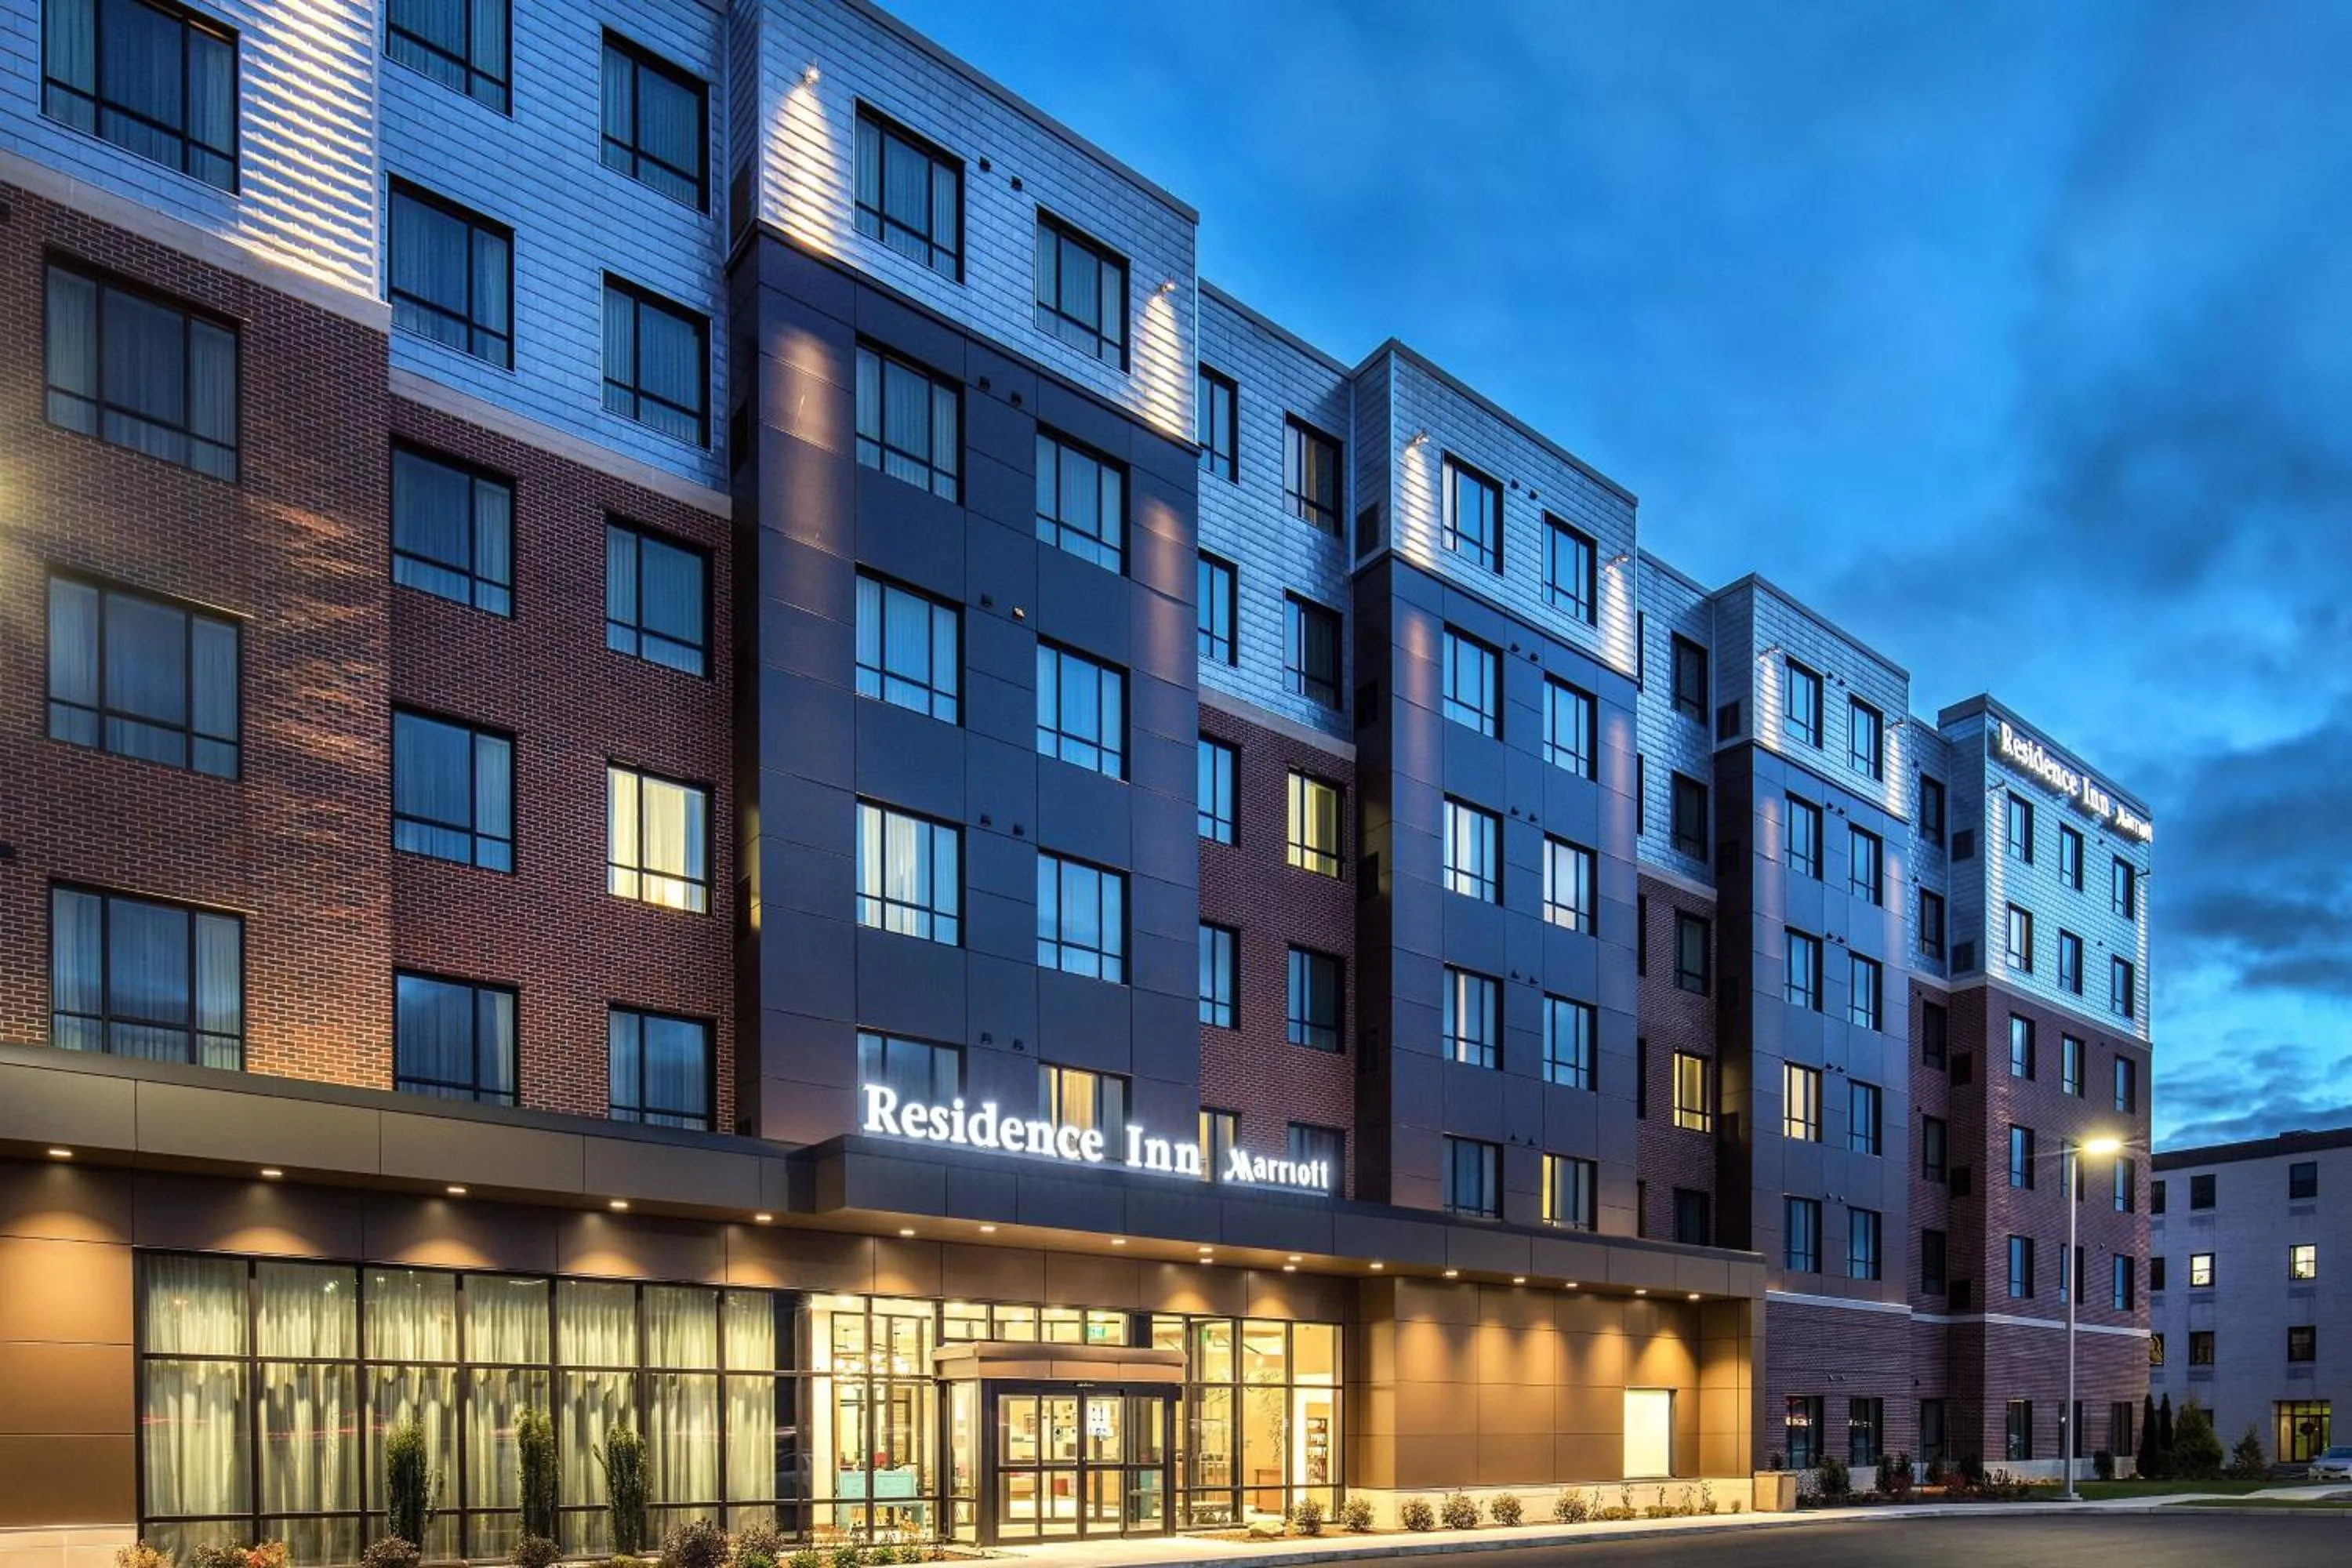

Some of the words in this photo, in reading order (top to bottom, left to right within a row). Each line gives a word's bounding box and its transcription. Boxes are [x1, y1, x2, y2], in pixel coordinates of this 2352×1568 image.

[2001, 722, 2078, 796] Residence
[2082, 777, 2109, 817] Inn
[863, 1084, 1103, 1160] Residence
[1127, 1125, 1201, 1174] Inn
[1223, 1149, 1328, 1189] Marriott
